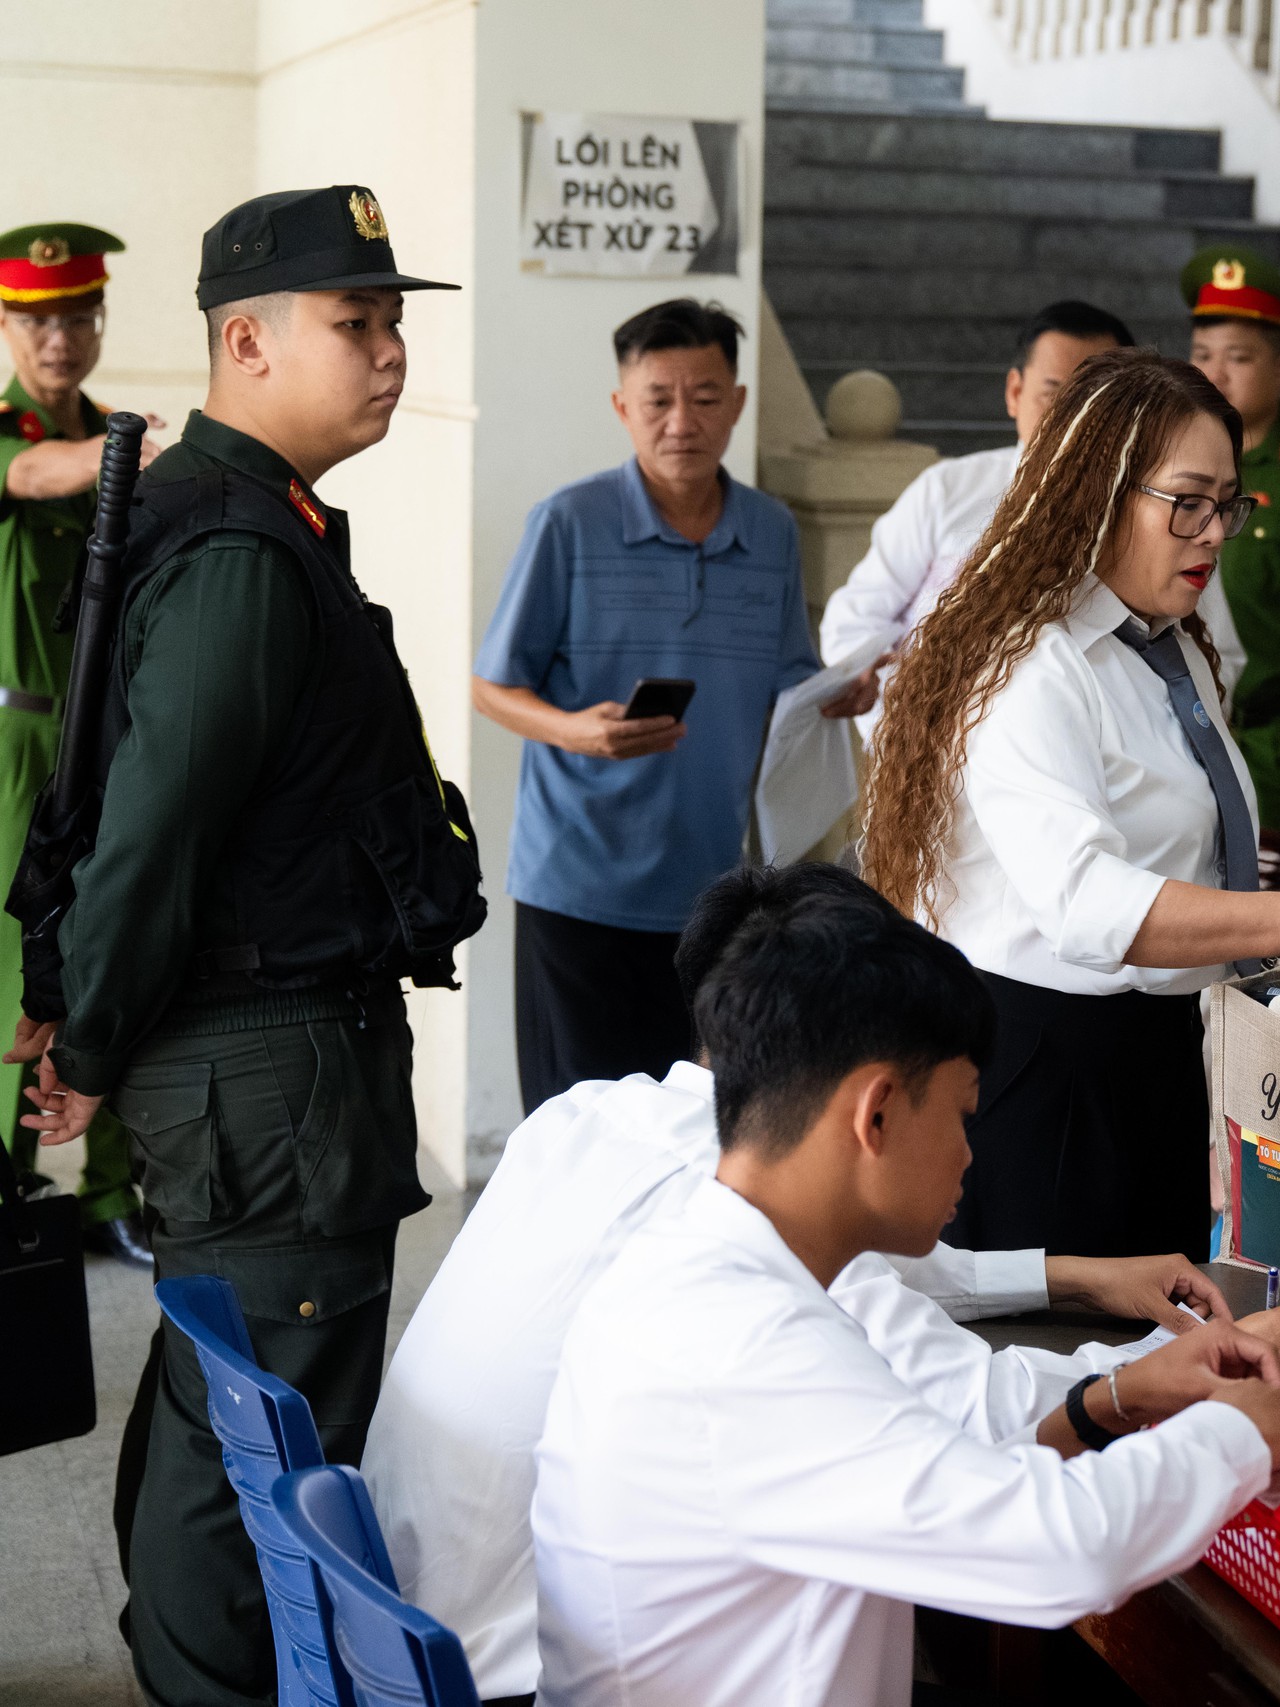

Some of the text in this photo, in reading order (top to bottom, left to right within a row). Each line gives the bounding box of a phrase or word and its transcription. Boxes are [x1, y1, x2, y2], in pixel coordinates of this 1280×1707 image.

[556, 131, 681, 170] LỐI LÊN
[562, 175, 676, 211] PHÒNG
[534, 216, 702, 253] XÉT XỬ 23
